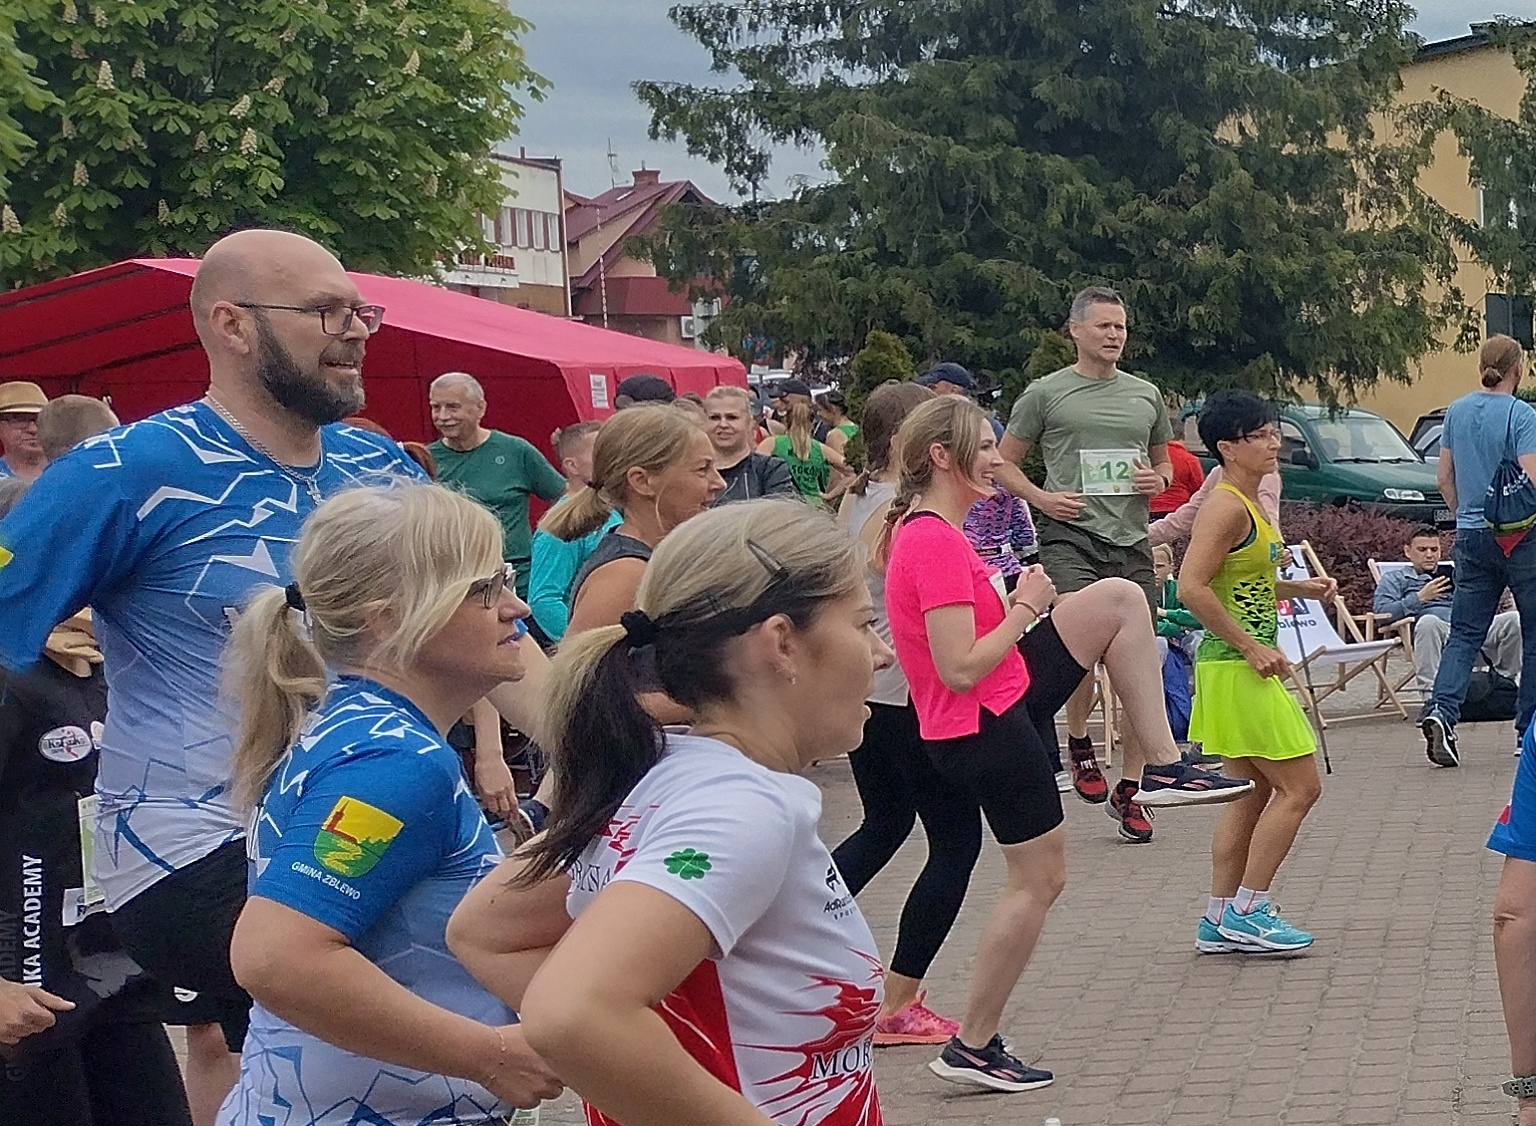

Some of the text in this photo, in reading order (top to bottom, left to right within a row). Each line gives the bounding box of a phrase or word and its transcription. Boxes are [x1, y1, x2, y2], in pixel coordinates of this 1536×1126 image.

[1100, 461, 1130, 480] 12
[291, 861, 361, 900] GMINA ZBLEWO
[22, 854, 43, 949] ACADEMY
